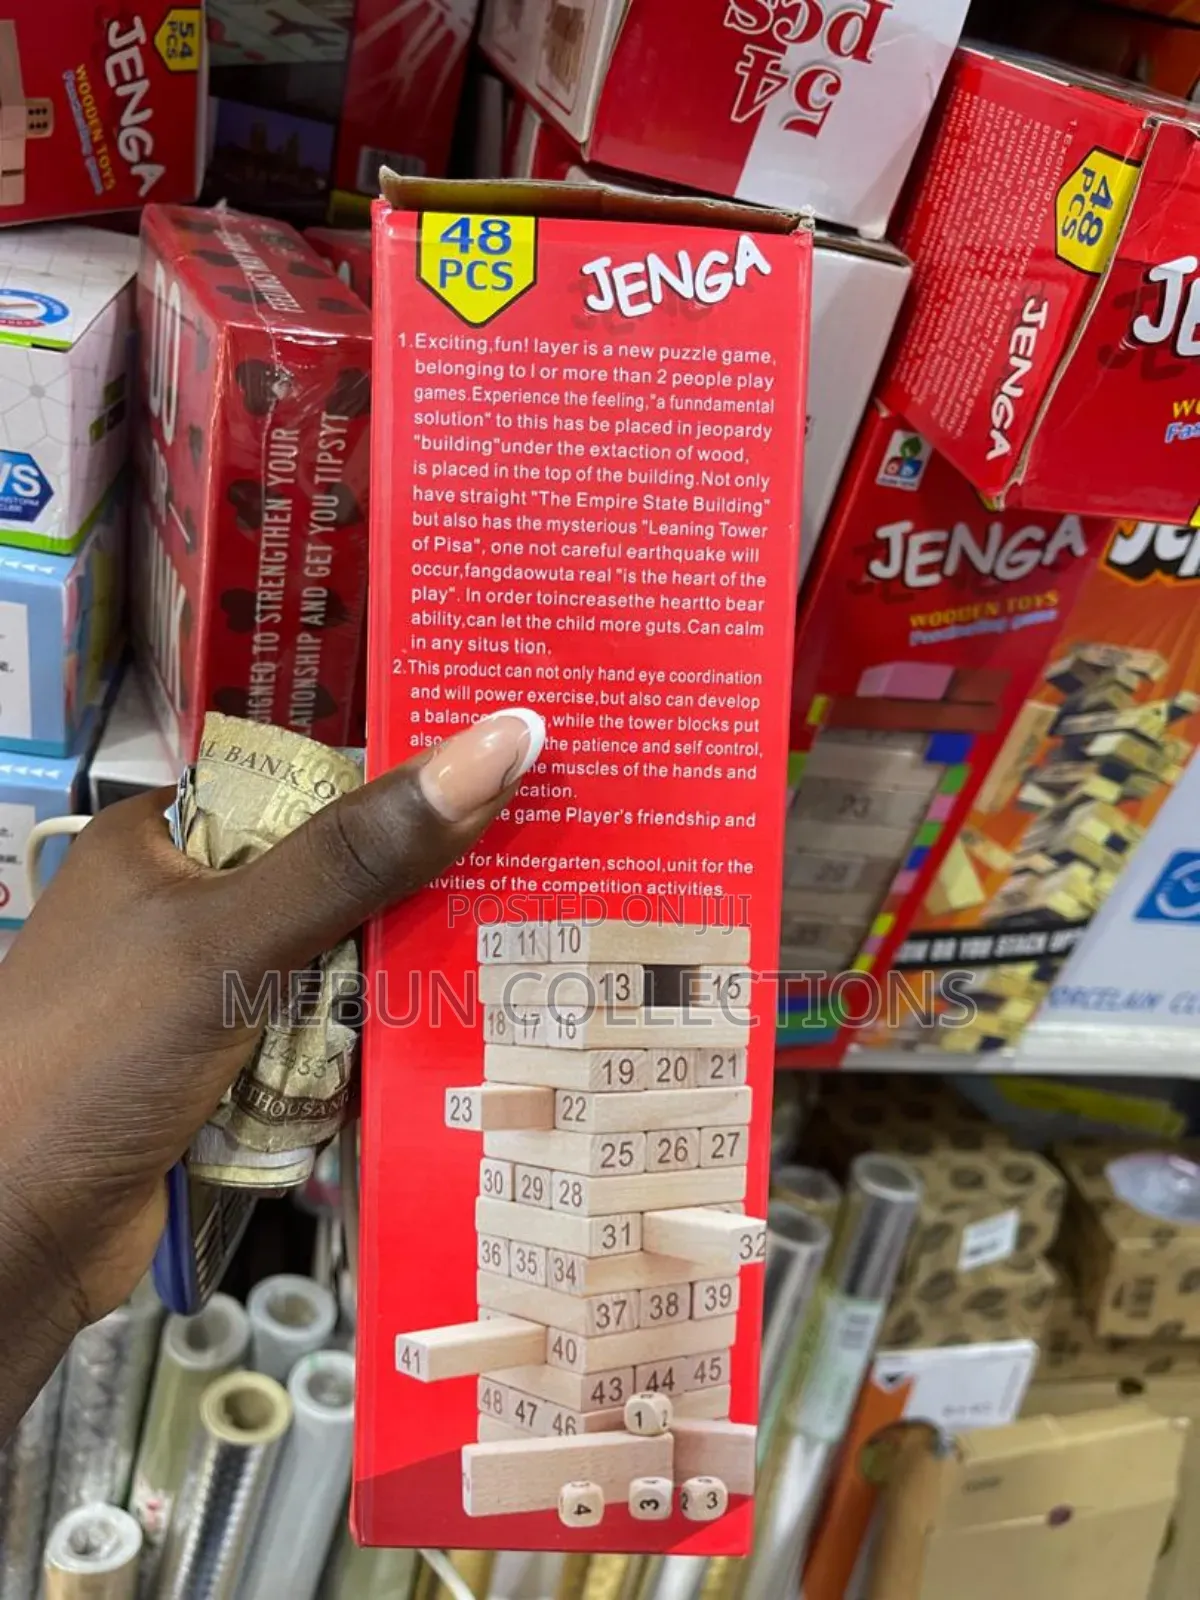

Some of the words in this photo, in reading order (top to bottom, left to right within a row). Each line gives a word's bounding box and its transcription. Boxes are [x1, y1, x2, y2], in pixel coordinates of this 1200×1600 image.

[166, 21, 178, 60] PCS
[178, 22, 195, 59] 54
[105, 15, 166, 197] JENGA
[730, 44, 842, 139] 54
[76, 63, 104, 143] WOODEN
[96, 143, 116, 191] TOYS
[1062, 167, 1096, 239] PCS
[1077, 175, 1114, 247] 48
[439, 217, 513, 256] 48
[439, 260, 514, 291] PCS
[581, 234, 772, 318] JENGA
[534, 338, 579, 358] layer
[582, 341, 598, 356] is
[602, 344, 613, 356] a
[618, 345, 655, 358] new
[659, 346, 718, 362] puzzle
[415, 358, 504, 381] belonging
[509, 363, 526, 378] to
[539, 367, 558, 380] or
[562, 368, 608, 382] more
[612, 366, 652, 384] than
[656, 368, 668, 384] 2
[672, 371, 732, 389] people
[737, 373, 774, 392] play
[986, 297, 1048, 461] JENGA
[496, 413, 512, 428] to
[517, 414, 548, 430] this
[553, 414, 584, 431] has
[589, 416, 610, 432] be
[614, 418, 673, 436] placed
[677, 420, 692, 435] in
[695, 421, 772, 442] jeopardy
[265, 426, 300, 497] YOUR
[413, 460, 428, 475] is
[432, 461, 489, 479] placed
[494, 463, 509, 478] in
[513, 464, 540, 480] the
[544, 466, 572, 483] top
[576, 466, 593, 482] of
[596, 468, 623, 483] the
[734, 473, 770, 493] only
[309, 494, 340, 535] YOU
[413, 484, 456, 503] have
[460, 488, 527, 508] straight
[576, 491, 638, 511] Empire
[642, 494, 688, 512] State
[412, 510, 439, 527] but
[442, 512, 478, 528] also
[482, 514, 512, 530] has
[516, 515, 542, 531] the
[546, 518, 638, 535] mysterious
[719, 521, 768, 538] Tower
[255, 498, 293, 625] STRENGTHEN
[304, 543, 334, 579] GET
[869, 514, 1088, 587] JENGA
[300, 586, 329, 627] AND
[1006, 590, 1059, 614] TOYS
[252, 631, 281, 655] TO
[501, 613, 522, 629] let
[526, 614, 552, 630] the
[556, 616, 595, 631] child
[600, 619, 642, 632] more
[724, 621, 764, 636] calm
[411, 634, 426, 649] in
[431, 638, 463, 656] any
[468, 636, 509, 653] situs
[444, 661, 502, 678] product
[504, 666, 532, 678] can
[536, 665, 560, 680] not
[562, 665, 594, 684] only
[598, 666, 635, 682] hand
[638, 670, 666, 686] eye
[669, 668, 762, 685] coordination
[410, 684, 440, 700] and
[444, 686, 470, 700] will
[474, 688, 524, 704] power
[628, 692, 662, 706] also
[665, 695, 694, 707] can
[697, 693, 760, 712] develop
[224, 745, 307, 787] BANK
[482, 931, 503, 958] 12
[518, 929, 537, 956] 11
[558, 926, 581, 954] 10
[599, 973, 630, 1003] 13
[712, 972, 741, 1001] 15
[488, 1010, 506, 1036] 18
[521, 1012, 540, 1039] 17
[556, 1012, 577, 1040] 16
[602, 1058, 635, 1086] 19
[656, 1056, 688, 1084] 20
[710, 1053, 738, 1081] 21
[450, 1094, 473, 1122] 23
[561, 1094, 587, 1122] 22
[601, 1141, 634, 1169] 25
[657, 1136, 689, 1164] 26
[710, 1131, 740, 1159] 27
[483, 1170, 504, 1196] 30
[521, 1174, 544, 1202] 29
[558, 1181, 583, 1208] 28
[602, 1221, 631, 1249] 31
[738, 1230, 766, 1260] 32
[481, 1240, 502, 1268] 36
[516, 1248, 538, 1276] 35
[553, 1257, 577, 1285] 34
[595, 1300, 628, 1329] 37
[649, 1291, 680, 1321] 38
[704, 1283, 733, 1312] 39
[401, 1347, 422, 1375] 41
[552, 1338, 577, 1366] 40
[591, 1376, 624, 1405] 43
[645, 1366, 676, 1393] 44
[694, 1357, 723, 1384] 45
[481, 1388, 504, 1416] 48
[514, 1400, 538, 1428] 47
[552, 1412, 577, 1437] 46
[634, 1411, 644, 1429] 1
[639, 1497, 661, 1511] 3
[706, 1491, 719, 1510] 3
